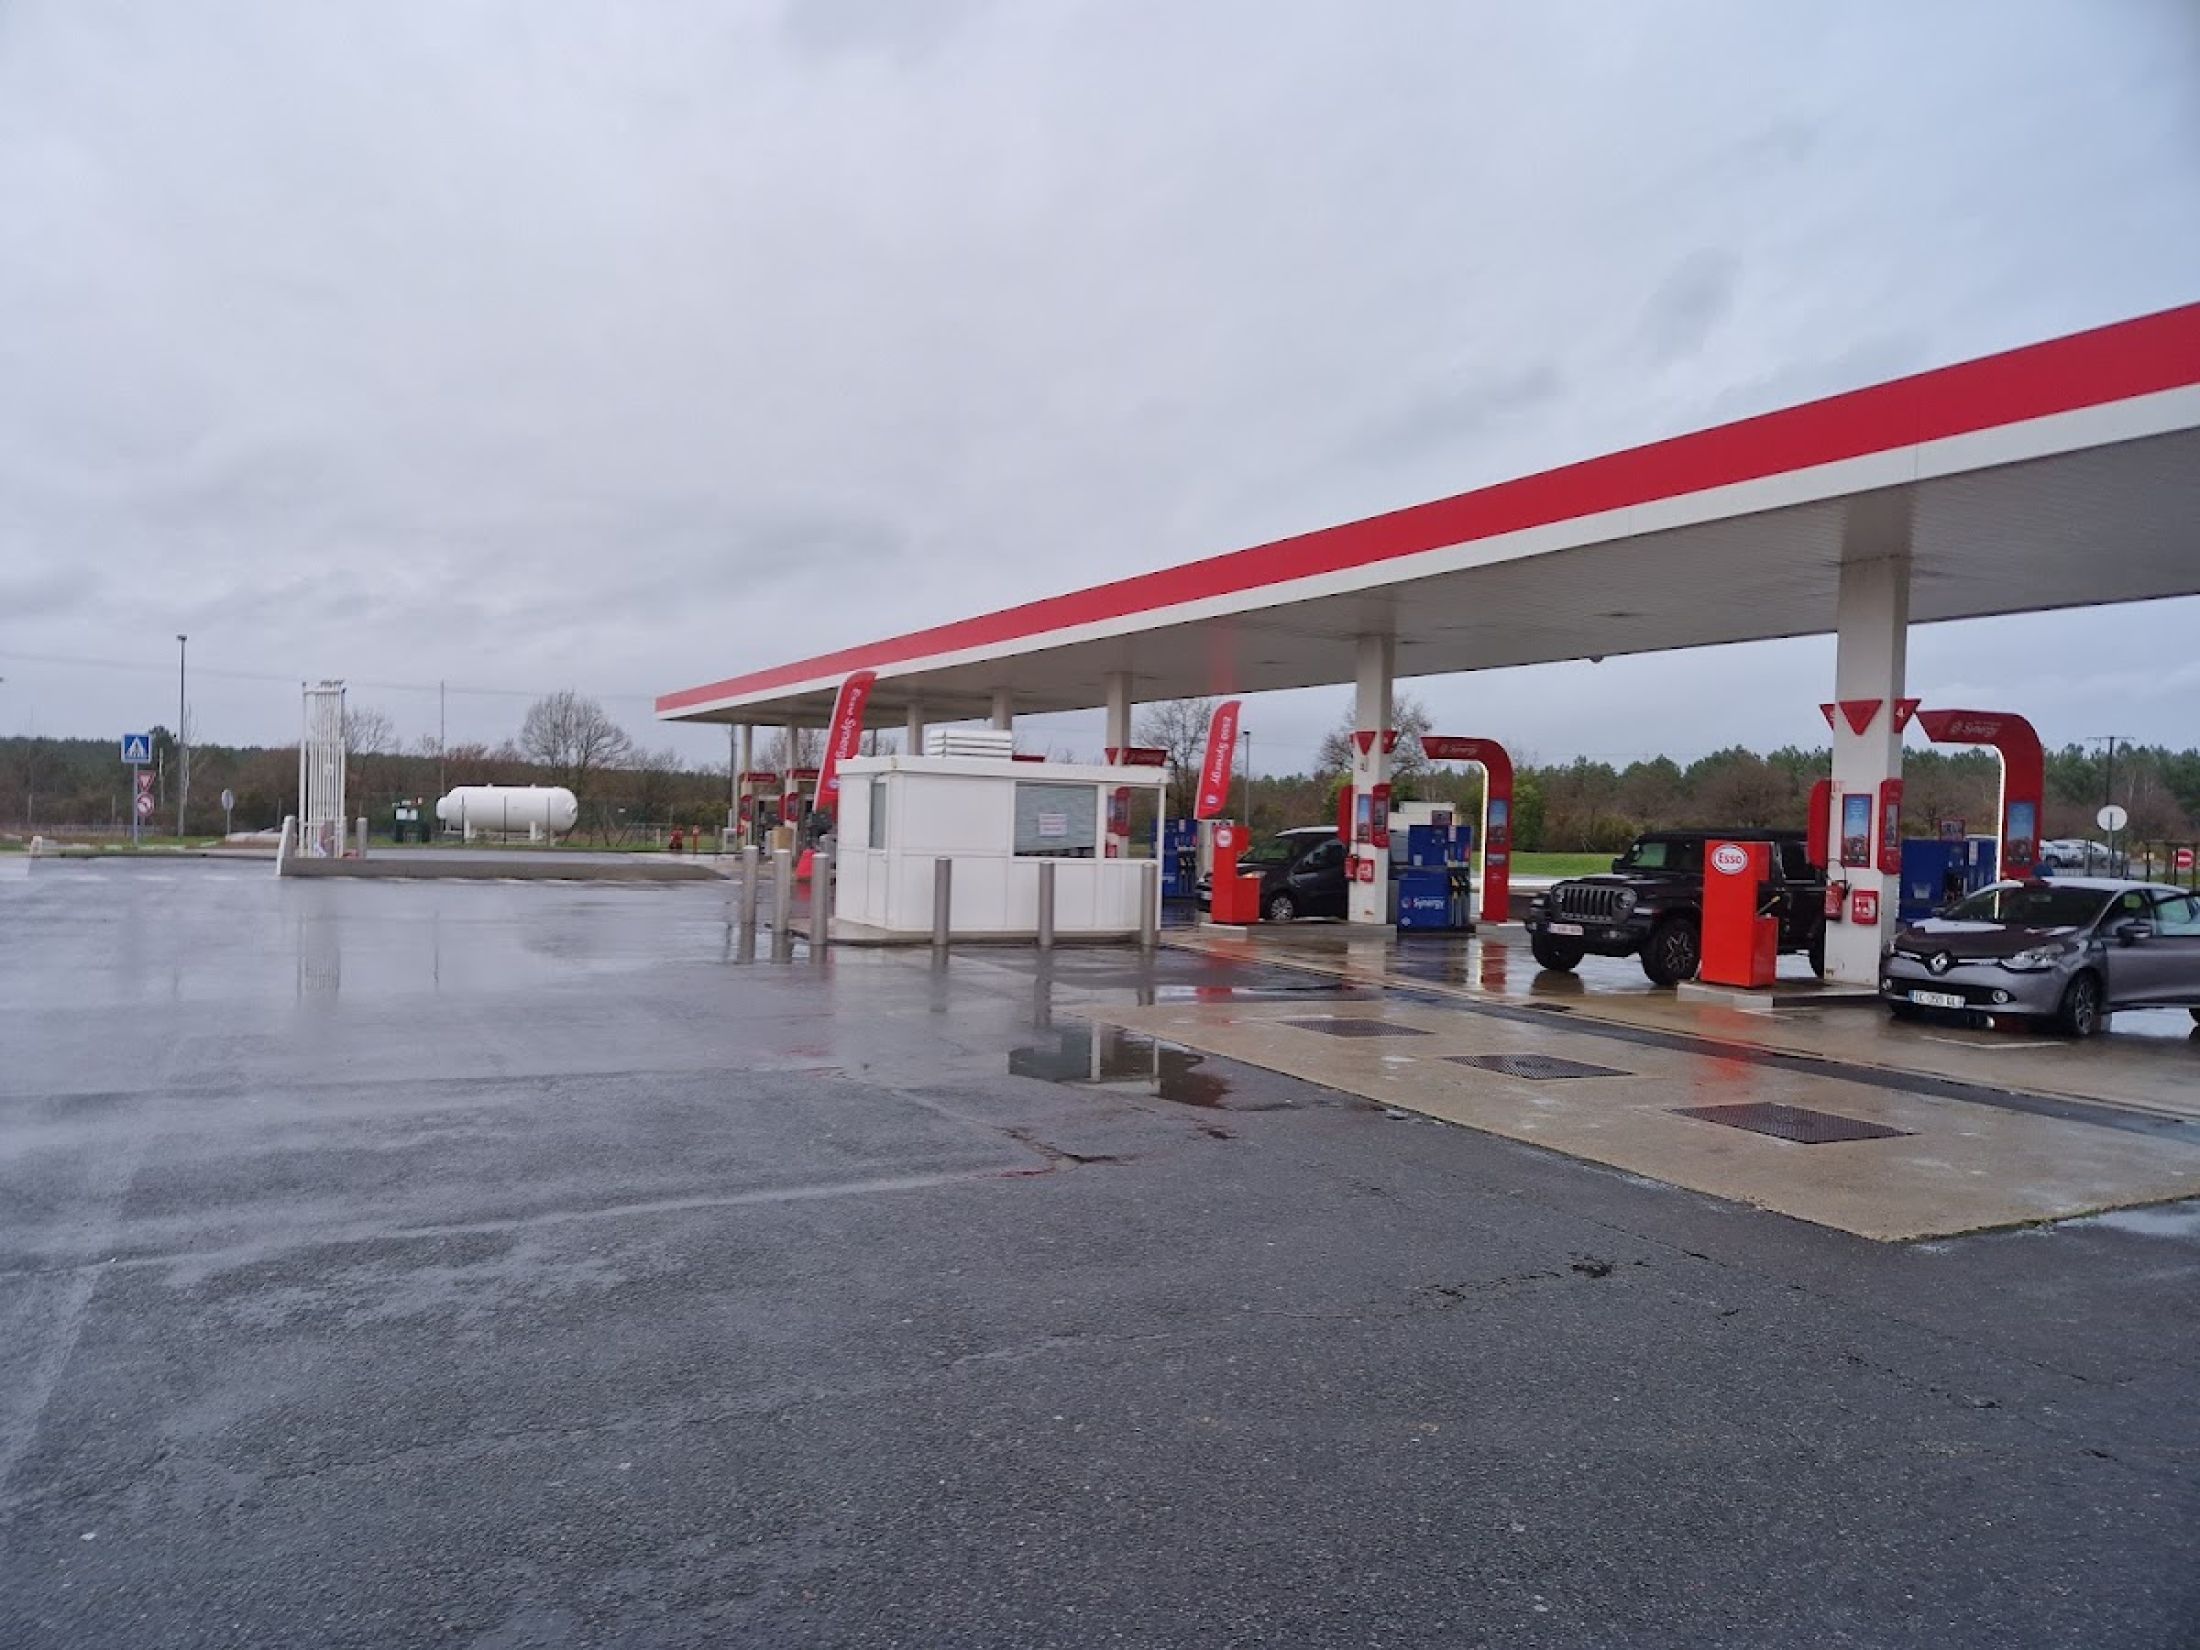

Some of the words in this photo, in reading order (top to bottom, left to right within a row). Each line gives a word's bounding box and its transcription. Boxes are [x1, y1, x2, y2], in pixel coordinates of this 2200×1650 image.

[836, 717, 857, 759] Synerg
[1220, 716, 1232, 740] Esso
[1209, 740, 1229, 786] Synergy
[1718, 851, 1742, 864] Esso
[1412, 897, 1444, 910] Synergy
